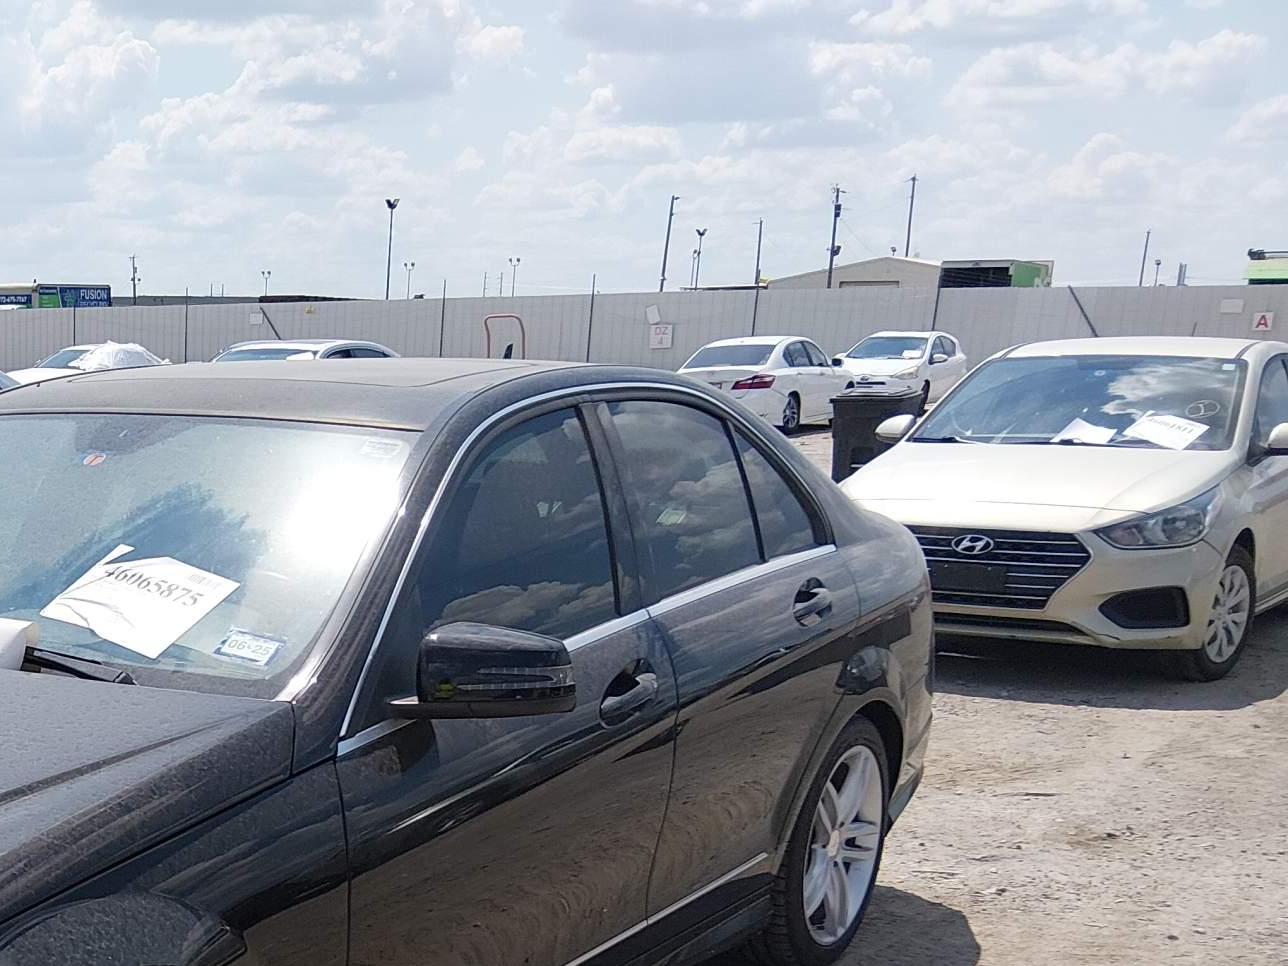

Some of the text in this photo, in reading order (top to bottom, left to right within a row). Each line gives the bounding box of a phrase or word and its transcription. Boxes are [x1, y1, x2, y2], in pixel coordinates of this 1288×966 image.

[80, 289, 108, 300] FUSION
[1255, 314, 1269, 329] A
[104, 564, 205, 607] 46065875
